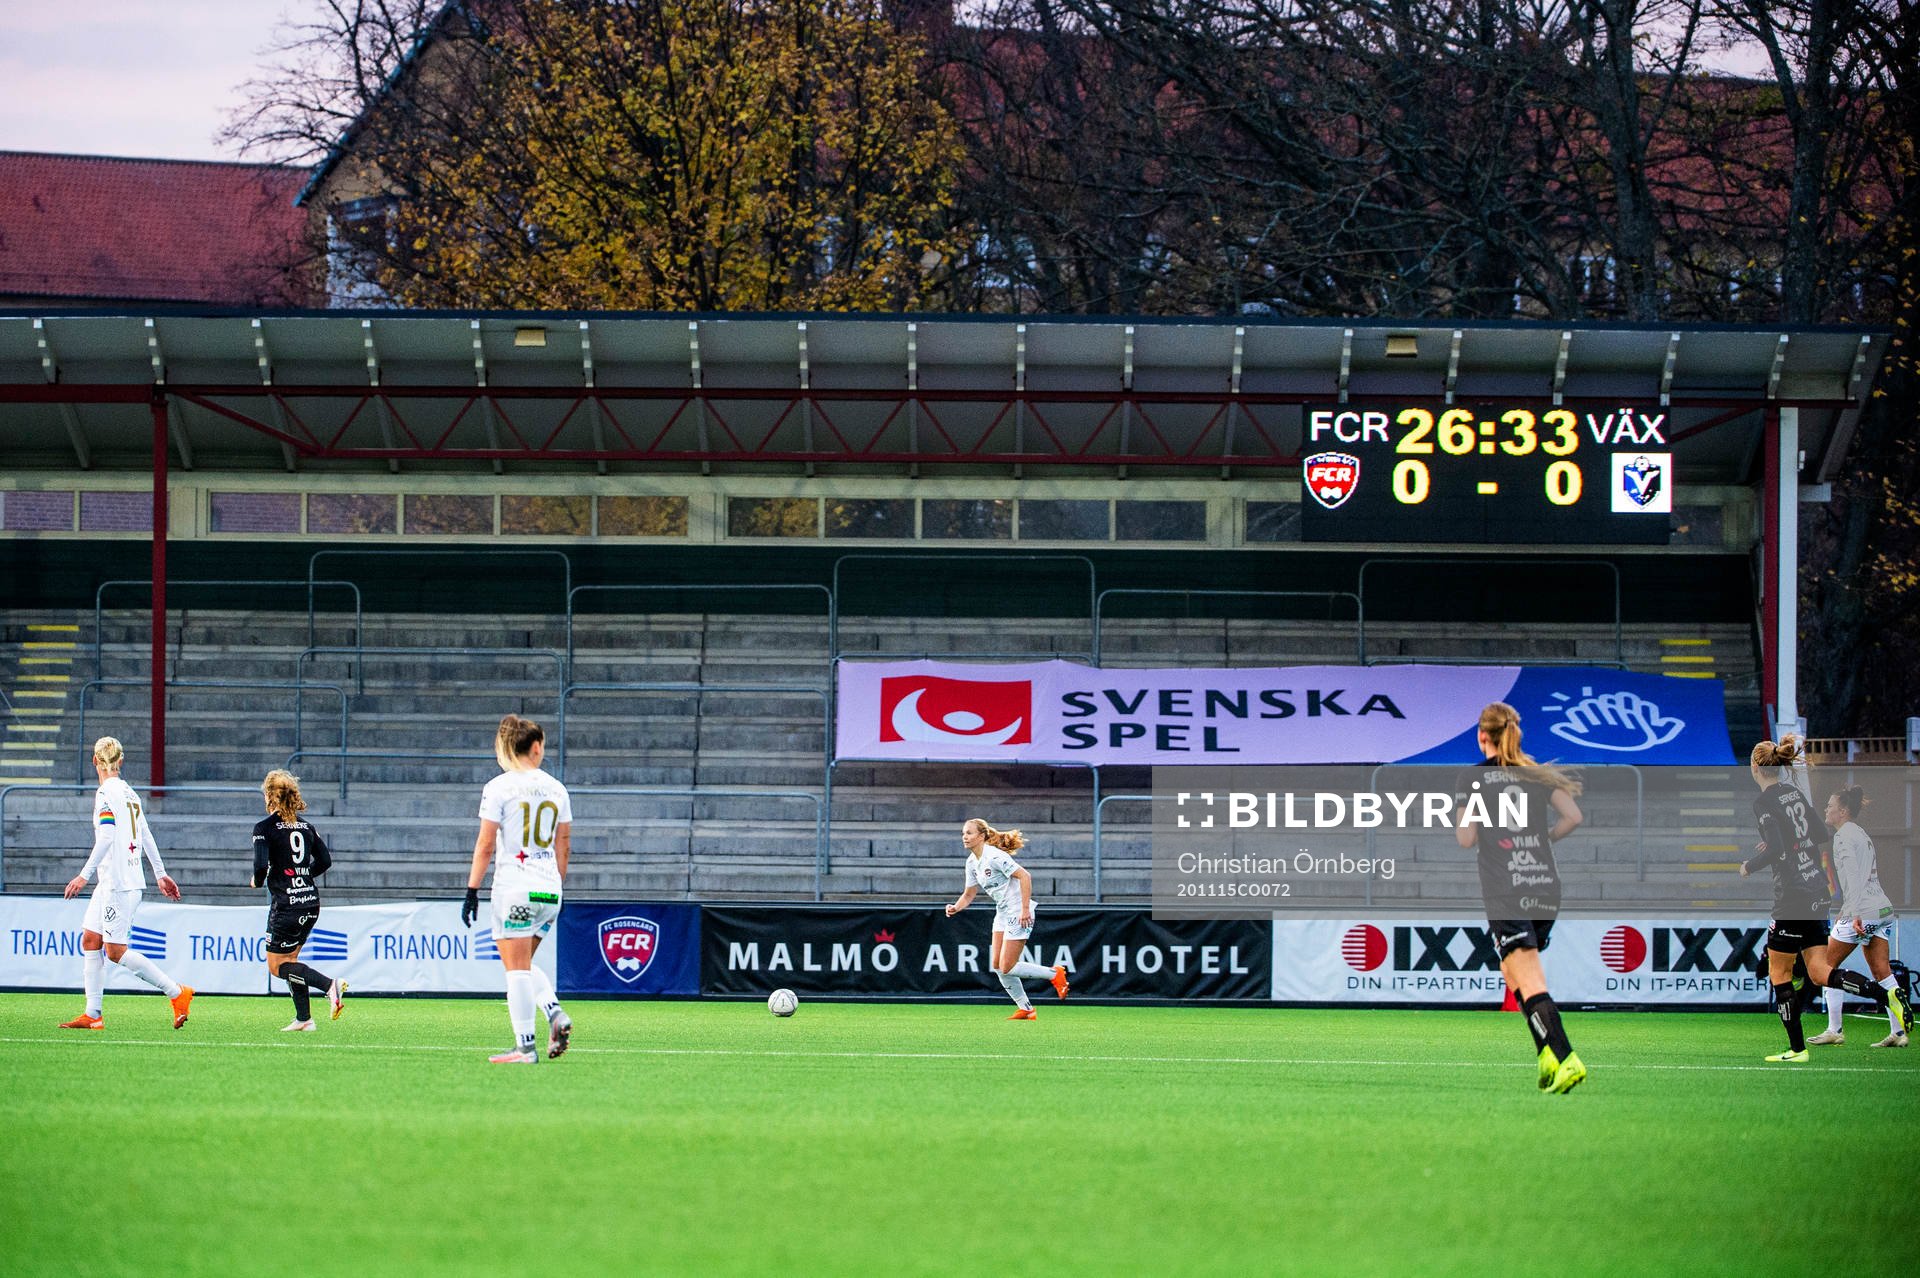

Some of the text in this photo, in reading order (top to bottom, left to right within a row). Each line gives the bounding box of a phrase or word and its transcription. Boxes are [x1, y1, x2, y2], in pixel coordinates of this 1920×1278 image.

[1310, 408, 1665, 456] FCR 26:33 VÄX
[1310, 467, 1351, 482] FCR
[1392, 459, 1430, 504] 0
[1545, 460, 1583, 506] 0
[1061, 688, 1407, 720] SVENSKA
[1061, 722, 1241, 752] SPEL
[126, 801, 140, 840] 17
[519, 800, 559, 848] 10
[289, 831, 305, 864] 9
[1511, 850, 1537, 865] ICA
[604, 920, 655, 932] FC ROSENGÅRD
[189, 934, 267, 962] TRIANO
[370, 934, 468, 960] TRIANON
[607, 933, 651, 950] FCR
[924, 942, 1078, 974] ARNA
[1102, 945, 1250, 975] HOTEL
[1347, 976, 1382, 990] DIN
[1606, 978, 1768, 991] DIN IT-PARTNER
